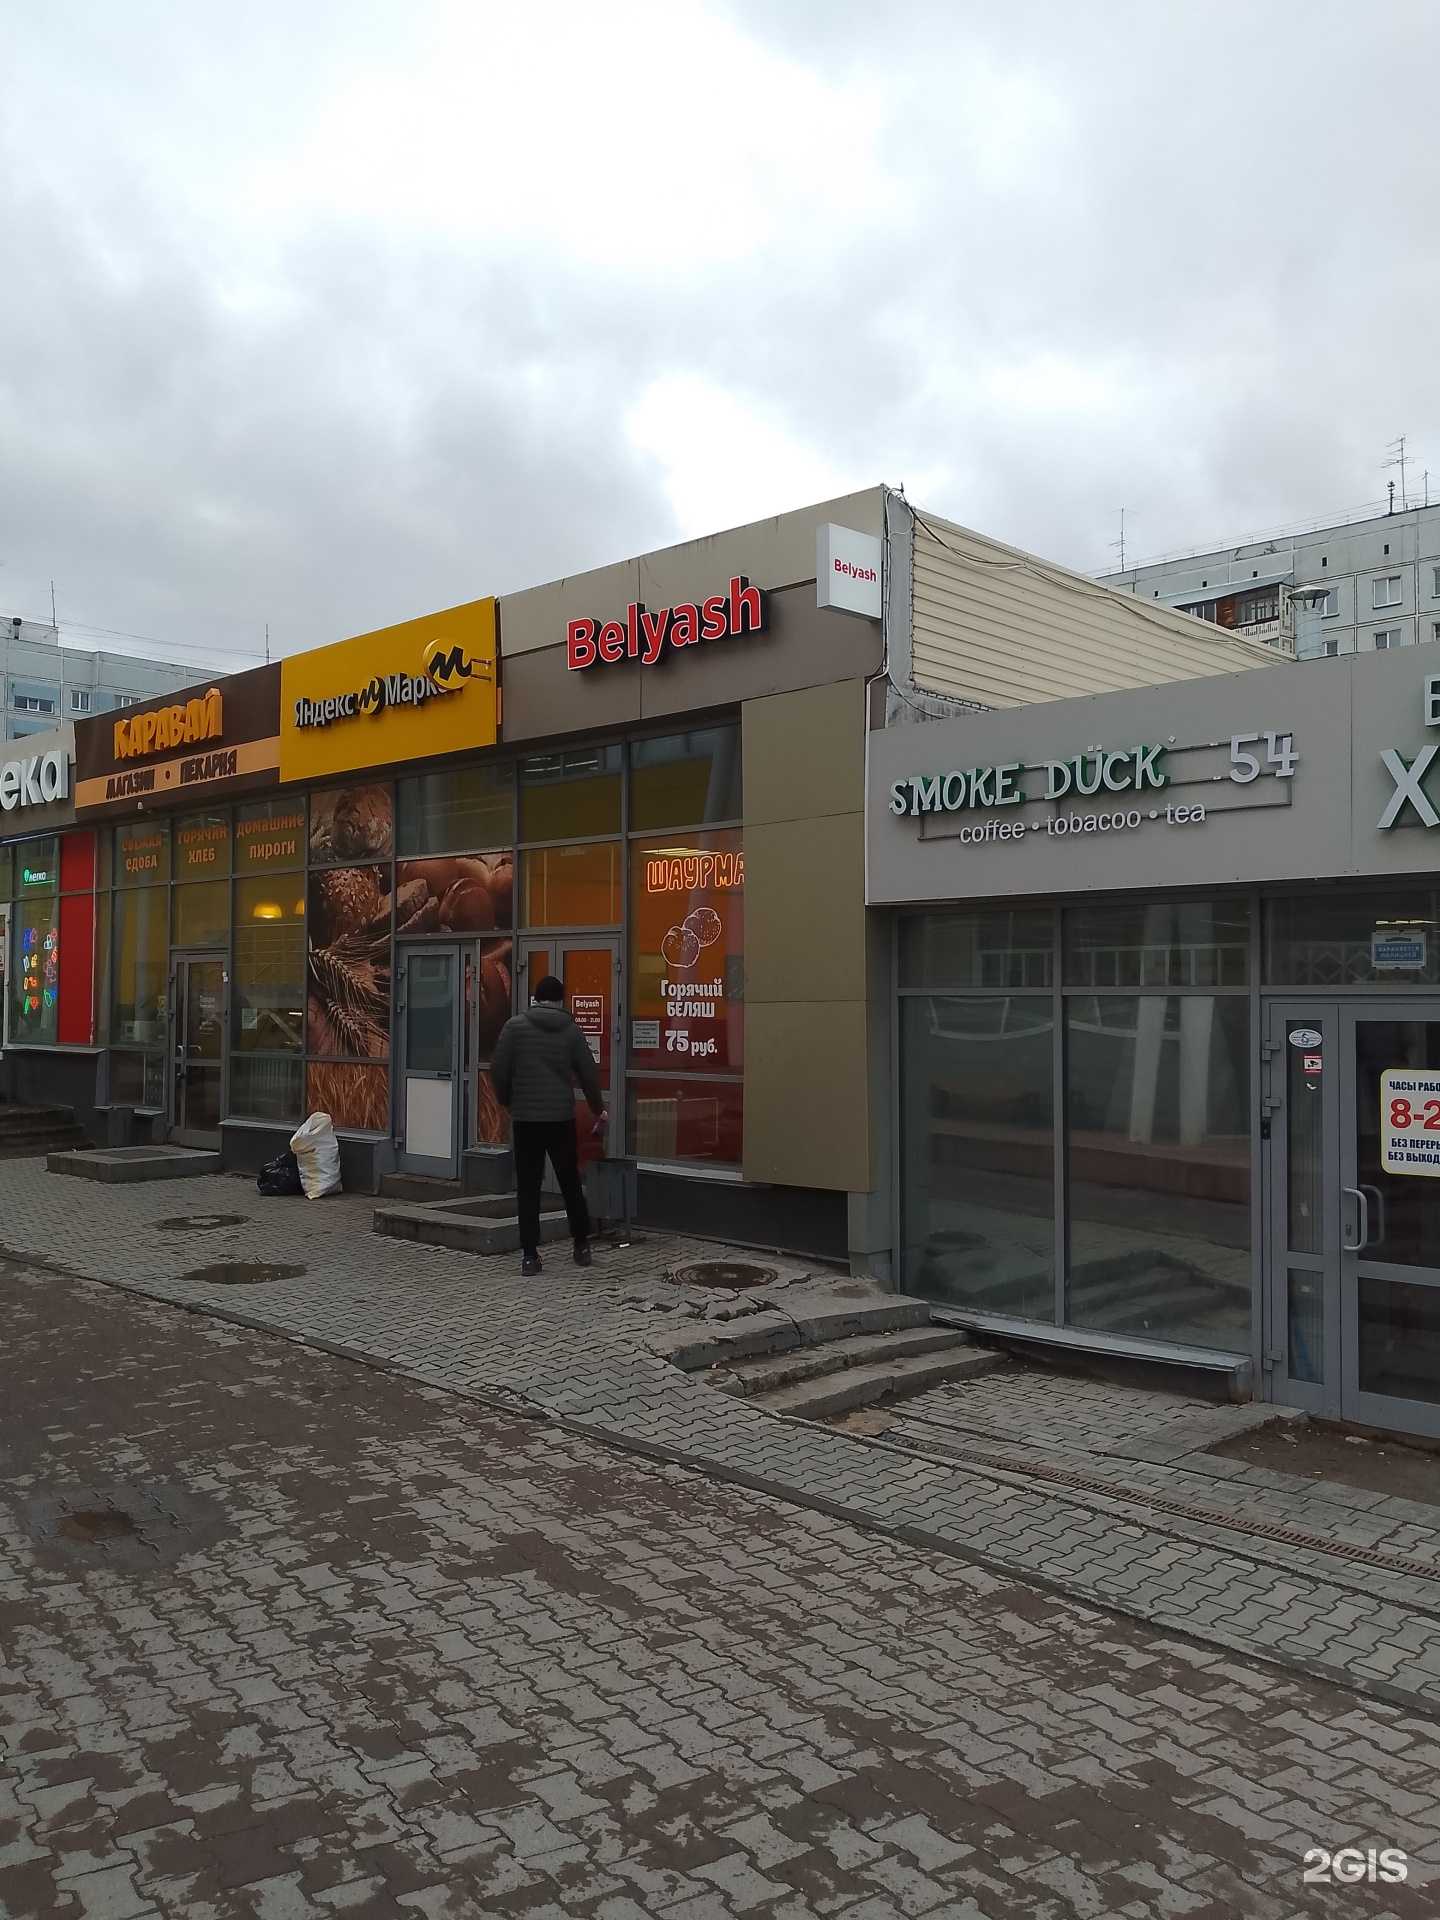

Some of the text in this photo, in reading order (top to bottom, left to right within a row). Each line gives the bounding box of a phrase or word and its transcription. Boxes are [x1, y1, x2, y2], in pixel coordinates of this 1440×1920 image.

[834, 558, 877, 582] Belyash
[567, 576, 763, 672] Belyash
[293, 672, 450, 727] Яндекс Марк
[113, 687, 223, 760] КАРАВАЙ
[106, 750, 238, 800] МАГАЗИН ПЕКАРНЯ
[889, 730, 1300, 816] SMOKE DÜCK 54
[959, 802, 1207, 845] coffee tobacoo tea
[660, 977, 724, 1002] Горячий
[666, 1001, 716, 1018] БЕЛЯШ
[664, 1030, 690, 1052] 75
[690, 1037, 718, 1057] руб.
[1389, 1080, 1416, 1091] ЧАСЫ
[1388, 1151, 1405, 1161] БЕЗ
[1391, 1137, 1408, 1148] БЕЗ
